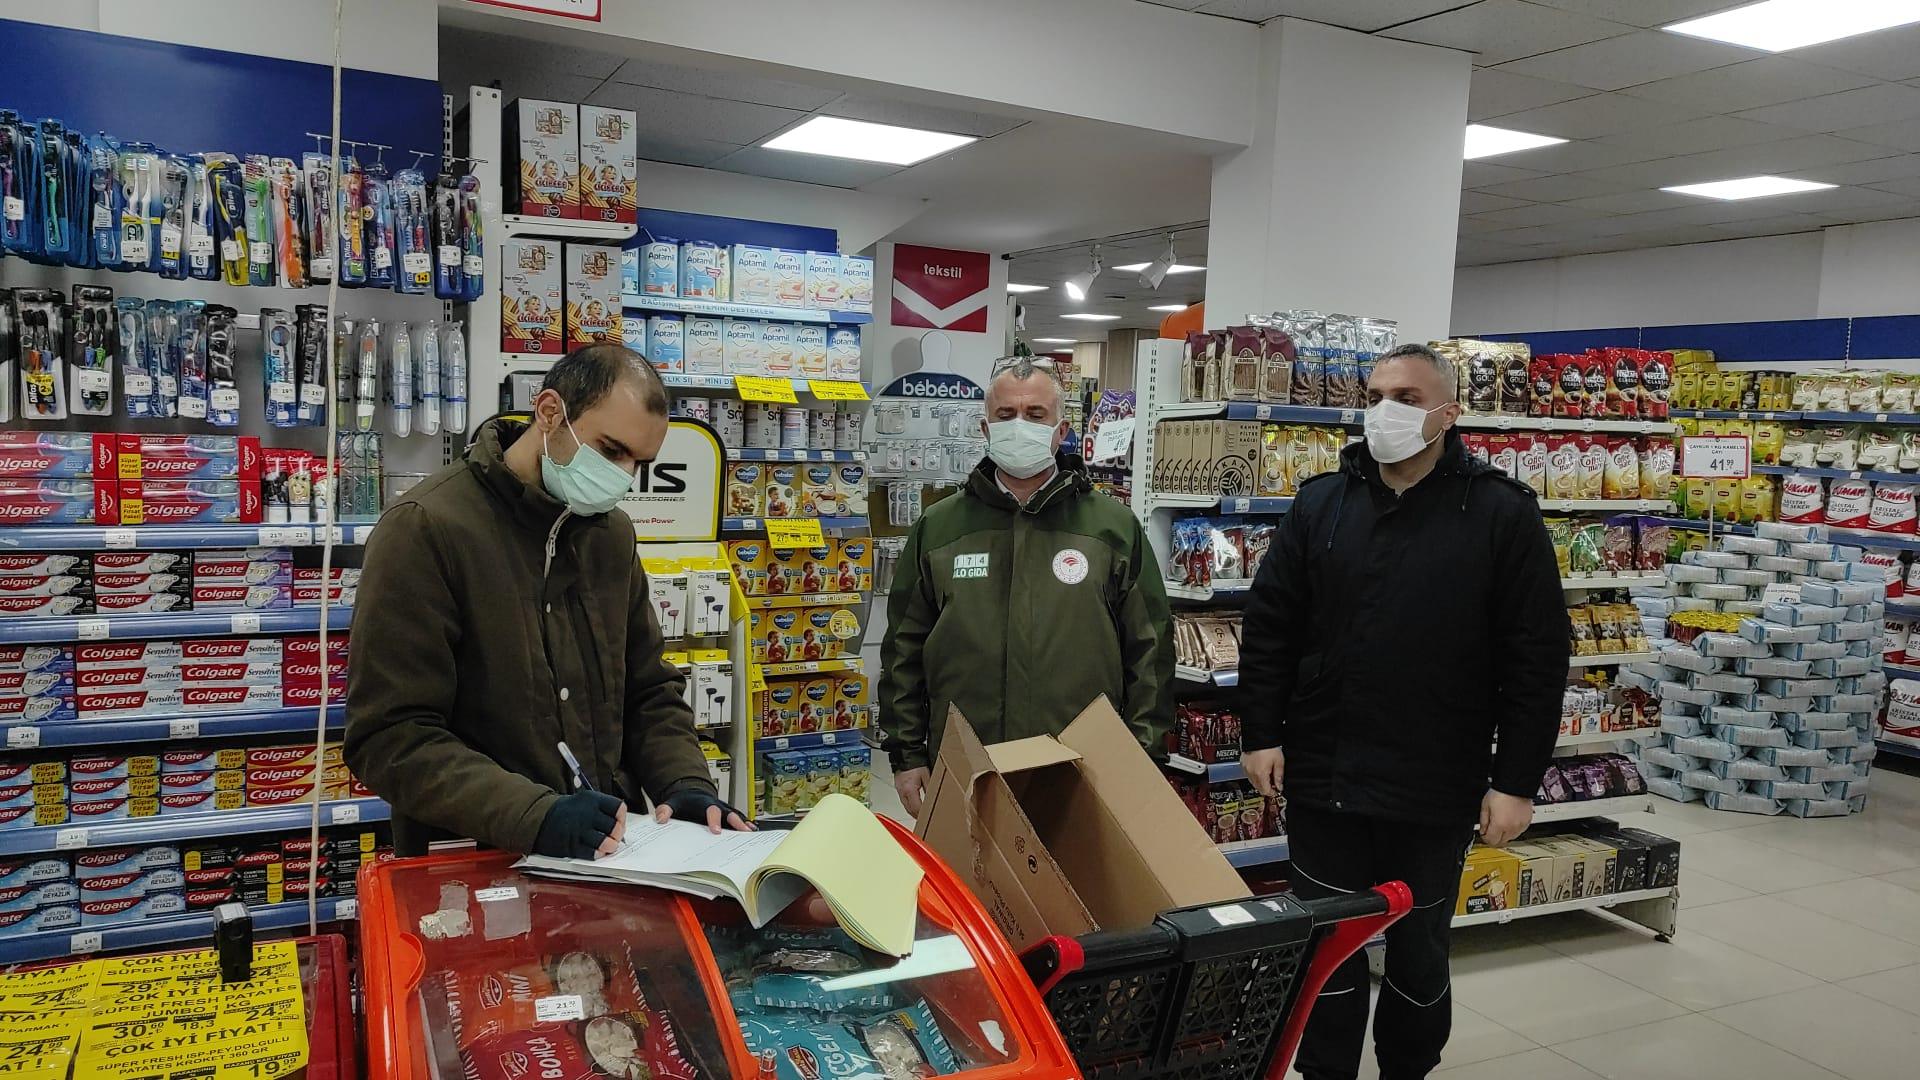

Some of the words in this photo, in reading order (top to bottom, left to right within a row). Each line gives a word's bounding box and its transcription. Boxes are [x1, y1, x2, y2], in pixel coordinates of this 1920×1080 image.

[648, 252, 675, 261] Aptamil
[738, 258, 767, 268] Aptamil
[774, 261, 800, 271] Aptamil
[809, 266, 836, 274] Aptamil
[844, 269, 870, 278] Aptamil
[924, 264, 962, 278] tekstil
[654, 330, 680, 338] Aptamil
[689, 329, 718, 338] Aptamil
[728, 330, 755, 339] Aptamil
[762, 333, 790, 342] Aptamil
[676, 360, 682, 368] 4
[141, 459, 197, 472] Colgate
[142, 505, 199, 517] Colgate
[98, 555, 141, 565] Colgate
[197, 565, 244, 577] Colgate
[968, 568, 988, 577] GIDA
[98, 576, 141, 585] Colgate
[197, 590, 244, 600] Colgate
[100, 596, 142, 605] Colgate
[145, 647, 181, 656] Sensitive
[187, 644, 243, 656] Colgate
[248, 645, 282, 653] Sensitive
[288, 641, 344, 652] Colgte
[81, 647, 140, 660] Colgate
[187, 666, 242, 679] Colgate
[247, 668, 280, 676] Sensitive
[287, 664, 342, 676] Colgte
[81, 672, 140, 684] Colgate
[145, 671, 181, 680] Sensitive
[188, 689, 243, 702] Colgate
[287, 687, 342, 698] Colgte
[83, 696, 141, 708] Colgate
[146, 694, 182, 704] Sensitive
[164, 752, 202, 762] Colgate
[250, 750, 305, 762] Colgate
[72, 760, 115, 771] Colgate
[163, 774, 202, 784] Colgate
[250, 769, 305, 781] Colgate
[72, 782, 114, 792] Colgate
[163, 794, 202, 804] Colgate
[250, 788, 305, 800] Colgate
[72, 802, 114, 812] Colgate
[78, 852, 126, 864] Colgate
[33, 868, 61, 876] BEYAZLIK
[188, 872, 225, 880] Colgate
[83, 876, 131, 888] Colgate
[43, 890, 71, 899] BEYAZLIK
[188, 892, 225, 901] Colgate
[84, 900, 132, 912] Colgate
[44, 914, 72, 922] BEYAZLIK
[122, 956, 164, 967] ÇOK
[115, 992, 160, 1005] ÇOK
[161, 997, 219, 1008] FRESH
[226, 985, 296, 1001] PATATES
[141, 1006, 206, 1019] JUMBO
[9, 1024, 60, 1033] PARMAK
[181, 1020, 215, 1030] 18.3
[105, 1041, 155, 1058] ÇOK
[162, 1033, 198, 1049] İYİ
[206, 1023, 270, 1042] FİYAT
[119, 1063, 172, 1075] PATATES
[176, 1055, 226, 1066] KROKET
[142, 1055, 183, 1065] FRESH
